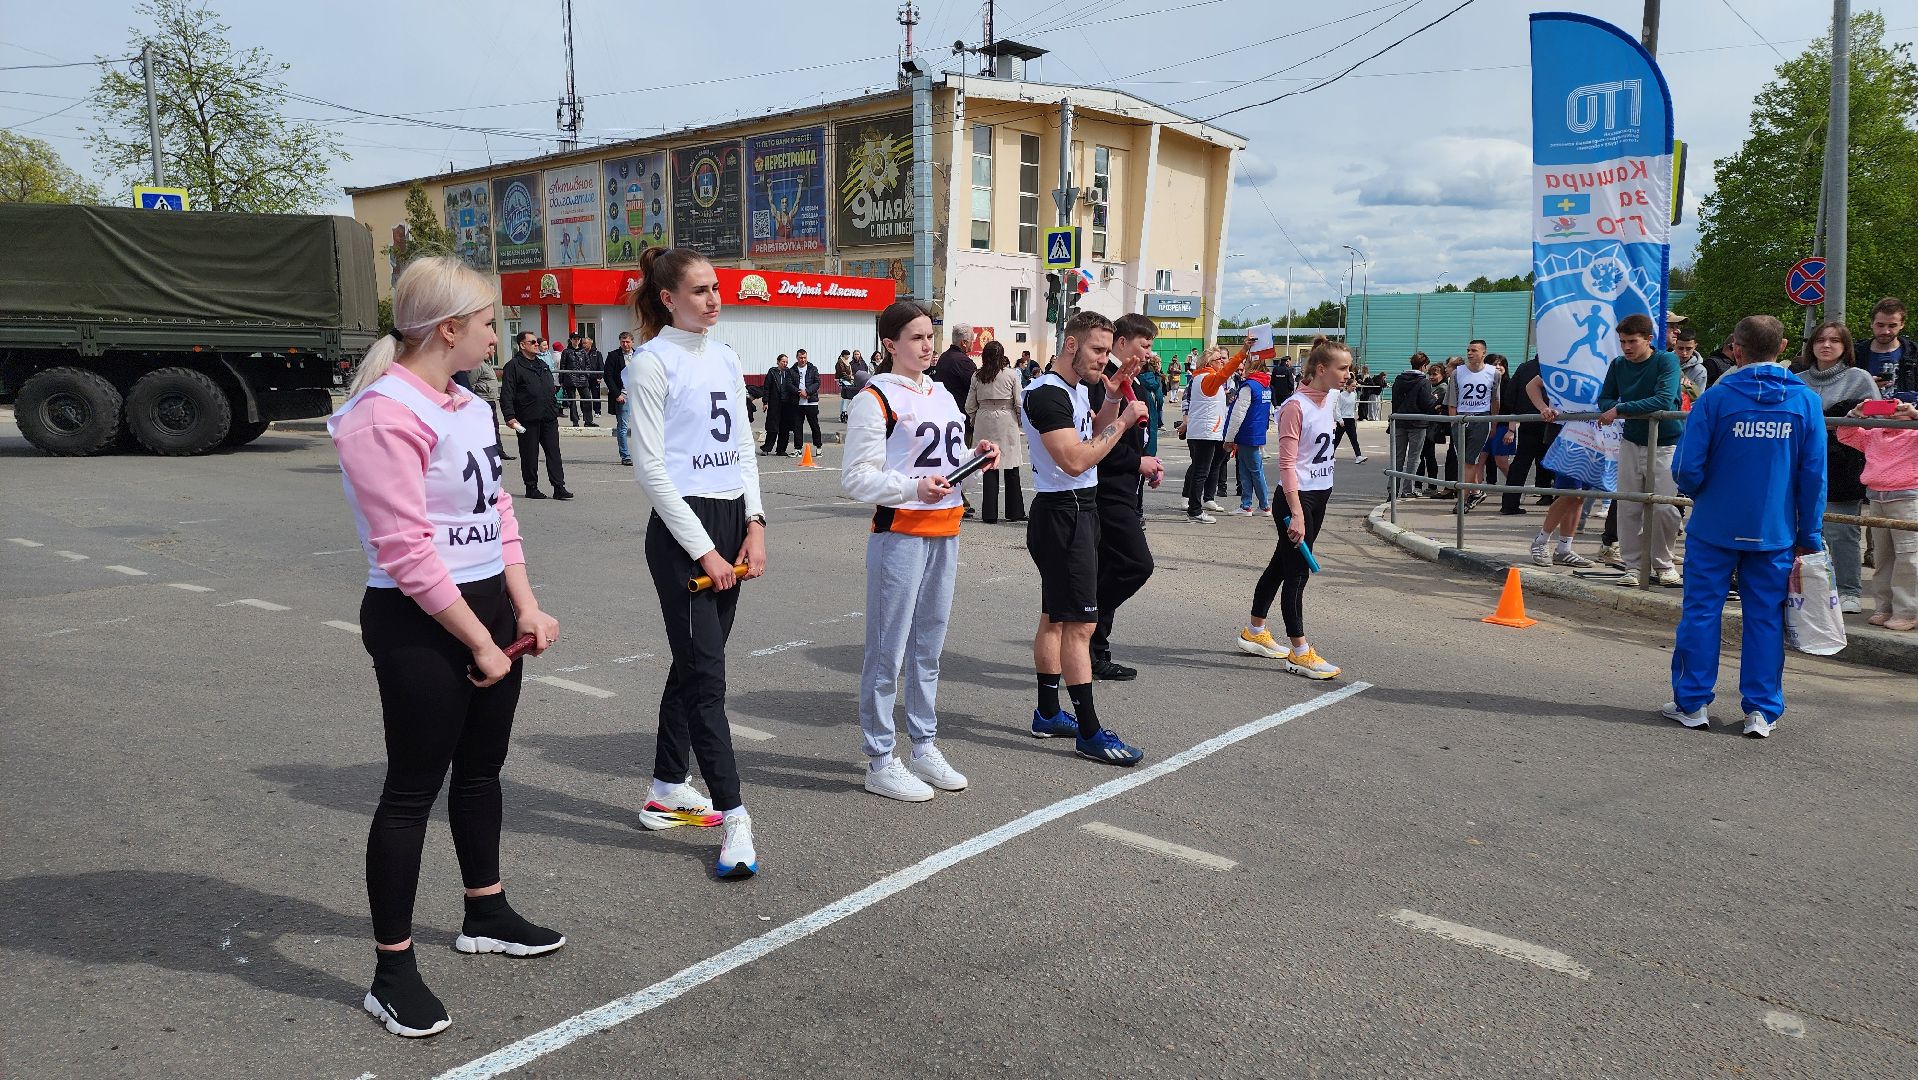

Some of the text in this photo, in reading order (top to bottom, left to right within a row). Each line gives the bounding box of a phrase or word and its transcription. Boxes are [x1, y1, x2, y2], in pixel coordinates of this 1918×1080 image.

[764, 147, 817, 171] ПЕРЕСТРОЙКА
[851, 188, 903, 229] 9 МАЯ
[870, 221, 913, 238] С ДНЕМ ПОБЕД
[755, 240, 818, 253] PERESTROYKA.PRO
[778, 280, 869, 298] Добрый Мясник
[1463, 383, 1487, 400] 29
[710, 391, 732, 443] 5
[1733, 421, 1792, 439] RUSSIA
[913, 420, 964, 468] 26
